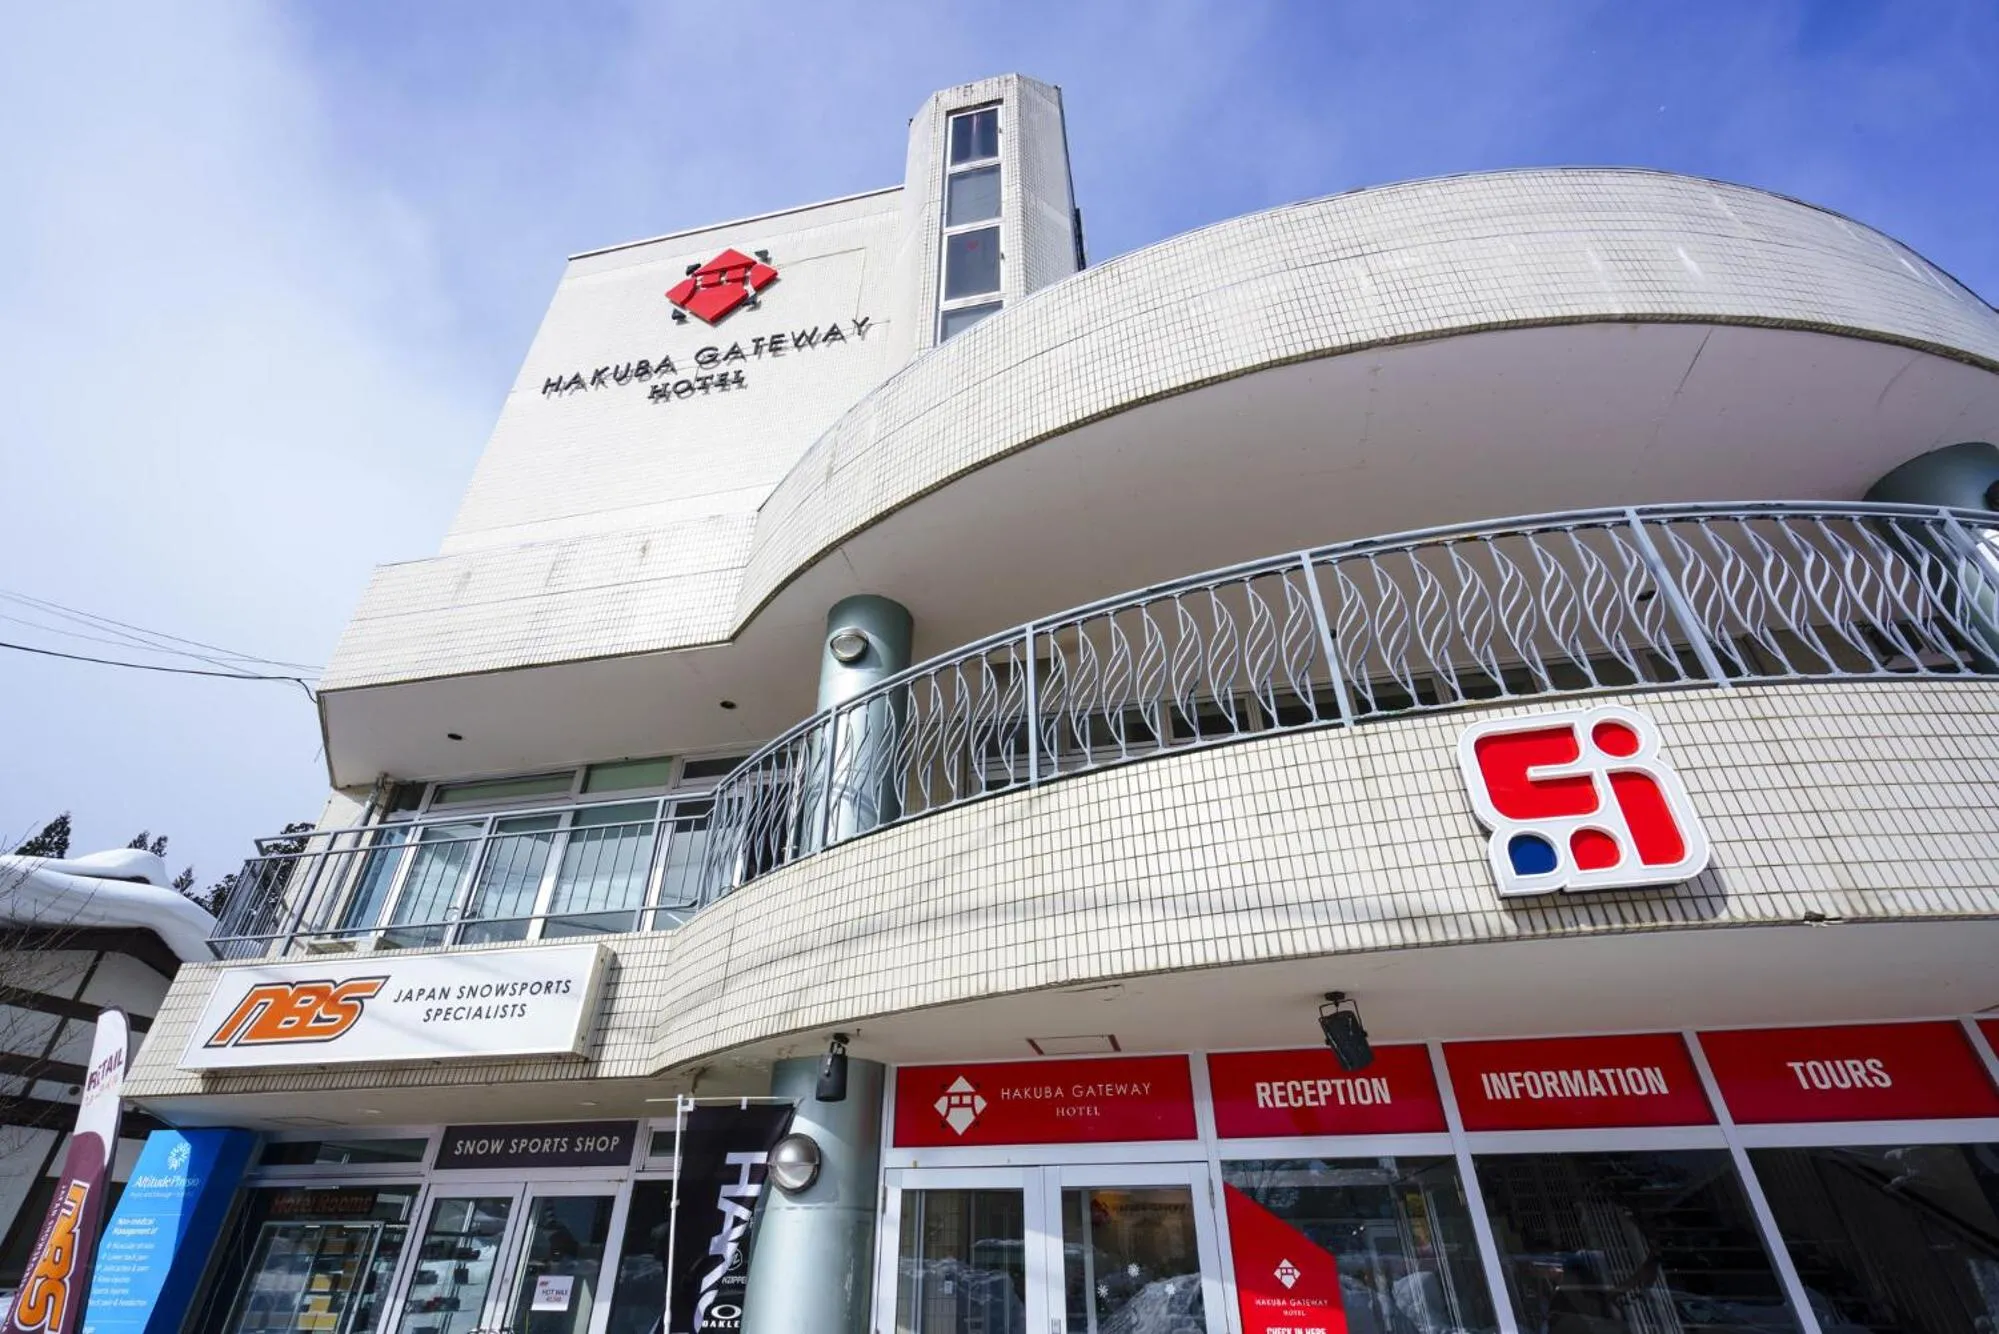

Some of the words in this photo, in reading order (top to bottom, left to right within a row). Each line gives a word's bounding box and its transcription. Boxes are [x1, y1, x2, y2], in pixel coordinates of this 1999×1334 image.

[541, 354, 677, 396] HAKUBA
[694, 316, 870, 366] GATEWAY
[648, 369, 746, 402] HOTEL
[393, 985, 451, 1003] JAPAN
[456, 979, 572, 1000] SNOWSPORTS
[423, 1003, 528, 1023] SPECIALISTS
[1481, 1066, 1669, 1100] INFORMATION
[1787, 1058, 1893, 1090] TOURS
[1001, 1086, 1064, 1100] HAKUBA
[1072, 1083, 1150, 1097] GATEWAY
[1256, 1077, 1391, 1109] RECEPTION
[1056, 1106, 1100, 1117] HOTEL
[454, 1138, 505, 1155] SNOW
[508, 1137, 569, 1154] SPORTS
[574, 1136, 620, 1152] SHOP
[1255, 1298, 1287, 1307] HAKUBA
[1289, 1297, 1328, 1307] GATEWAY
